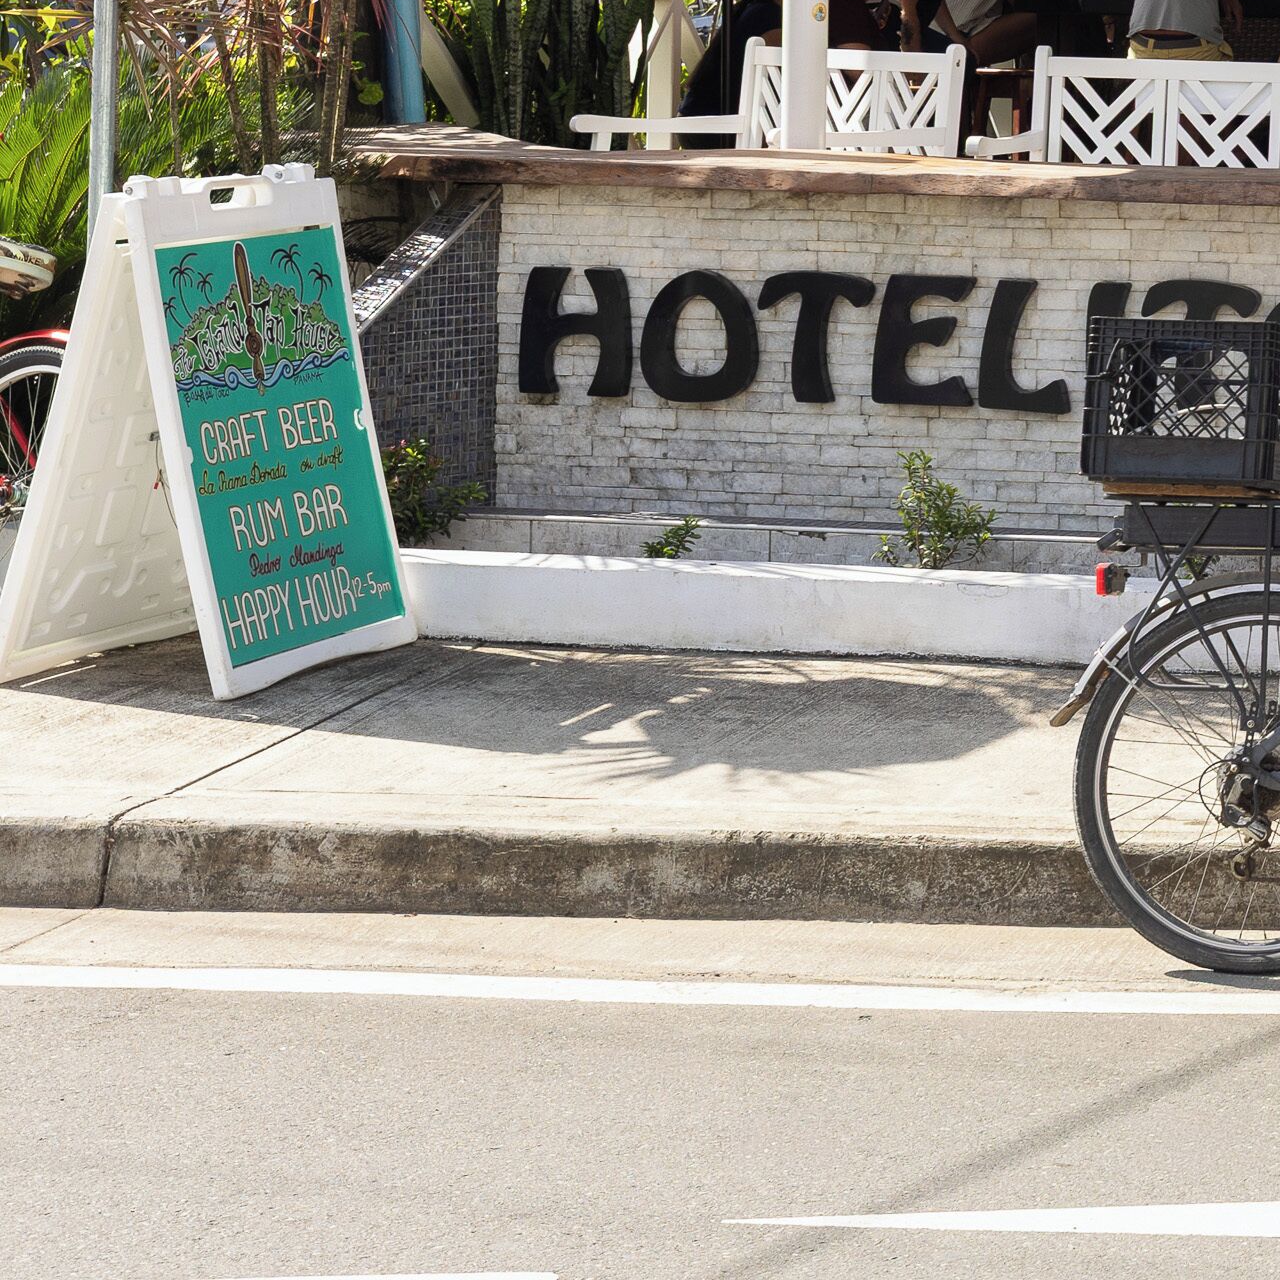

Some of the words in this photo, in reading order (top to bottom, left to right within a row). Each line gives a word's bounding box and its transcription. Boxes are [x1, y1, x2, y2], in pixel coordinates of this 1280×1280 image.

[185, 301, 247, 373] Island
[248, 290, 286, 360] Tap
[286, 302, 342, 361] House
[200, 409, 268, 466] CRAFT
[278, 398, 339, 450] BEER
[198, 470, 216, 496] La
[249, 461, 288, 486] Dorada
[317, 445, 344, 471] draft
[228, 497, 290, 552] RUM
[293, 483, 349, 537] BAR
[249, 552, 282, 578] Pedro
[289, 541, 345, 568] Mandinga
[222, 580, 295, 650] HAPPY
[294, 565, 357, 627] HOUR
[351, 572, 392, 600] 12-5pm
